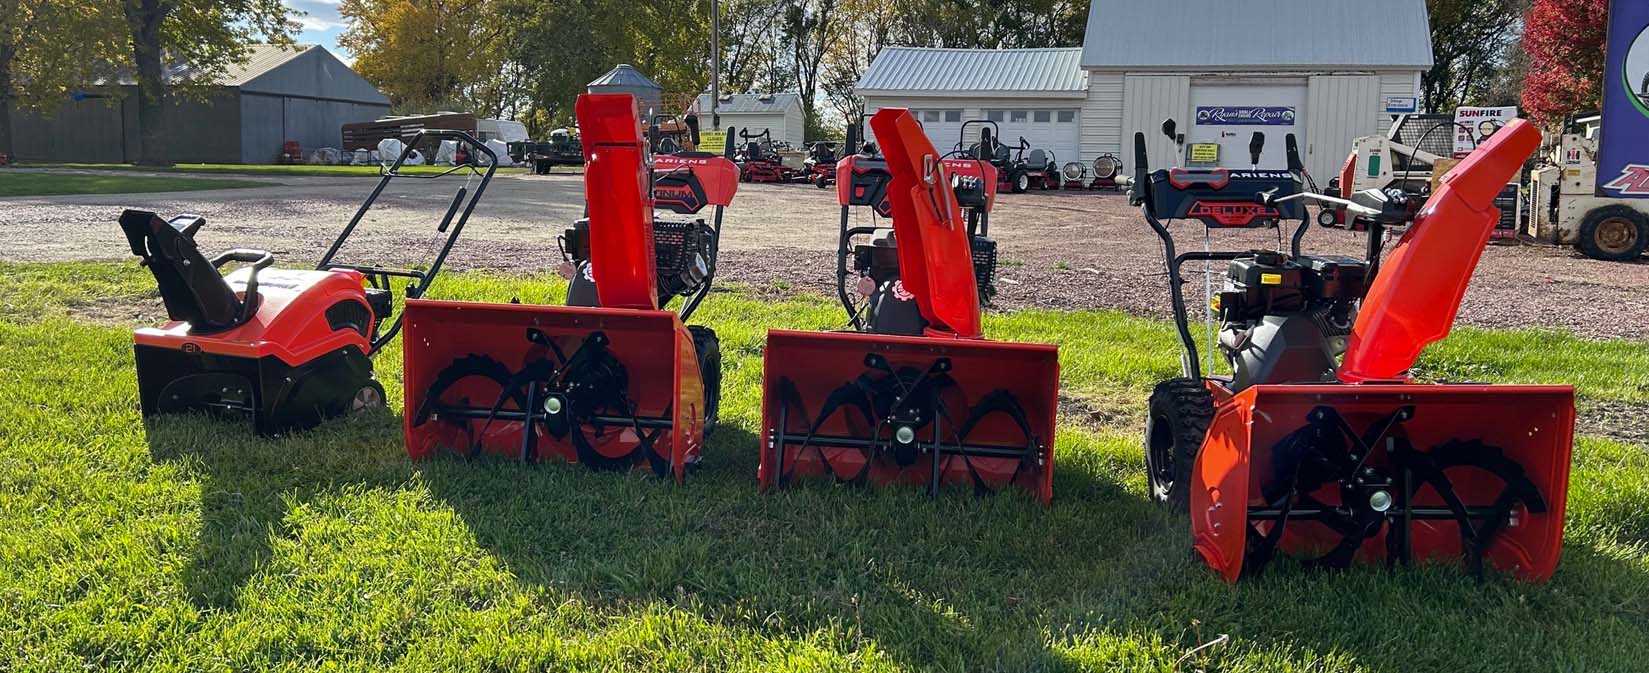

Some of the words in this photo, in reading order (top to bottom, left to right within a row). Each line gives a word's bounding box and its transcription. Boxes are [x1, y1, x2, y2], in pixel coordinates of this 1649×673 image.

[1250, 107, 1281, 122] Repair
[1459, 109, 1503, 117] SUNFIRE
[1200, 206, 1267, 215] DELUXE
[185, 344, 196, 353] 21
